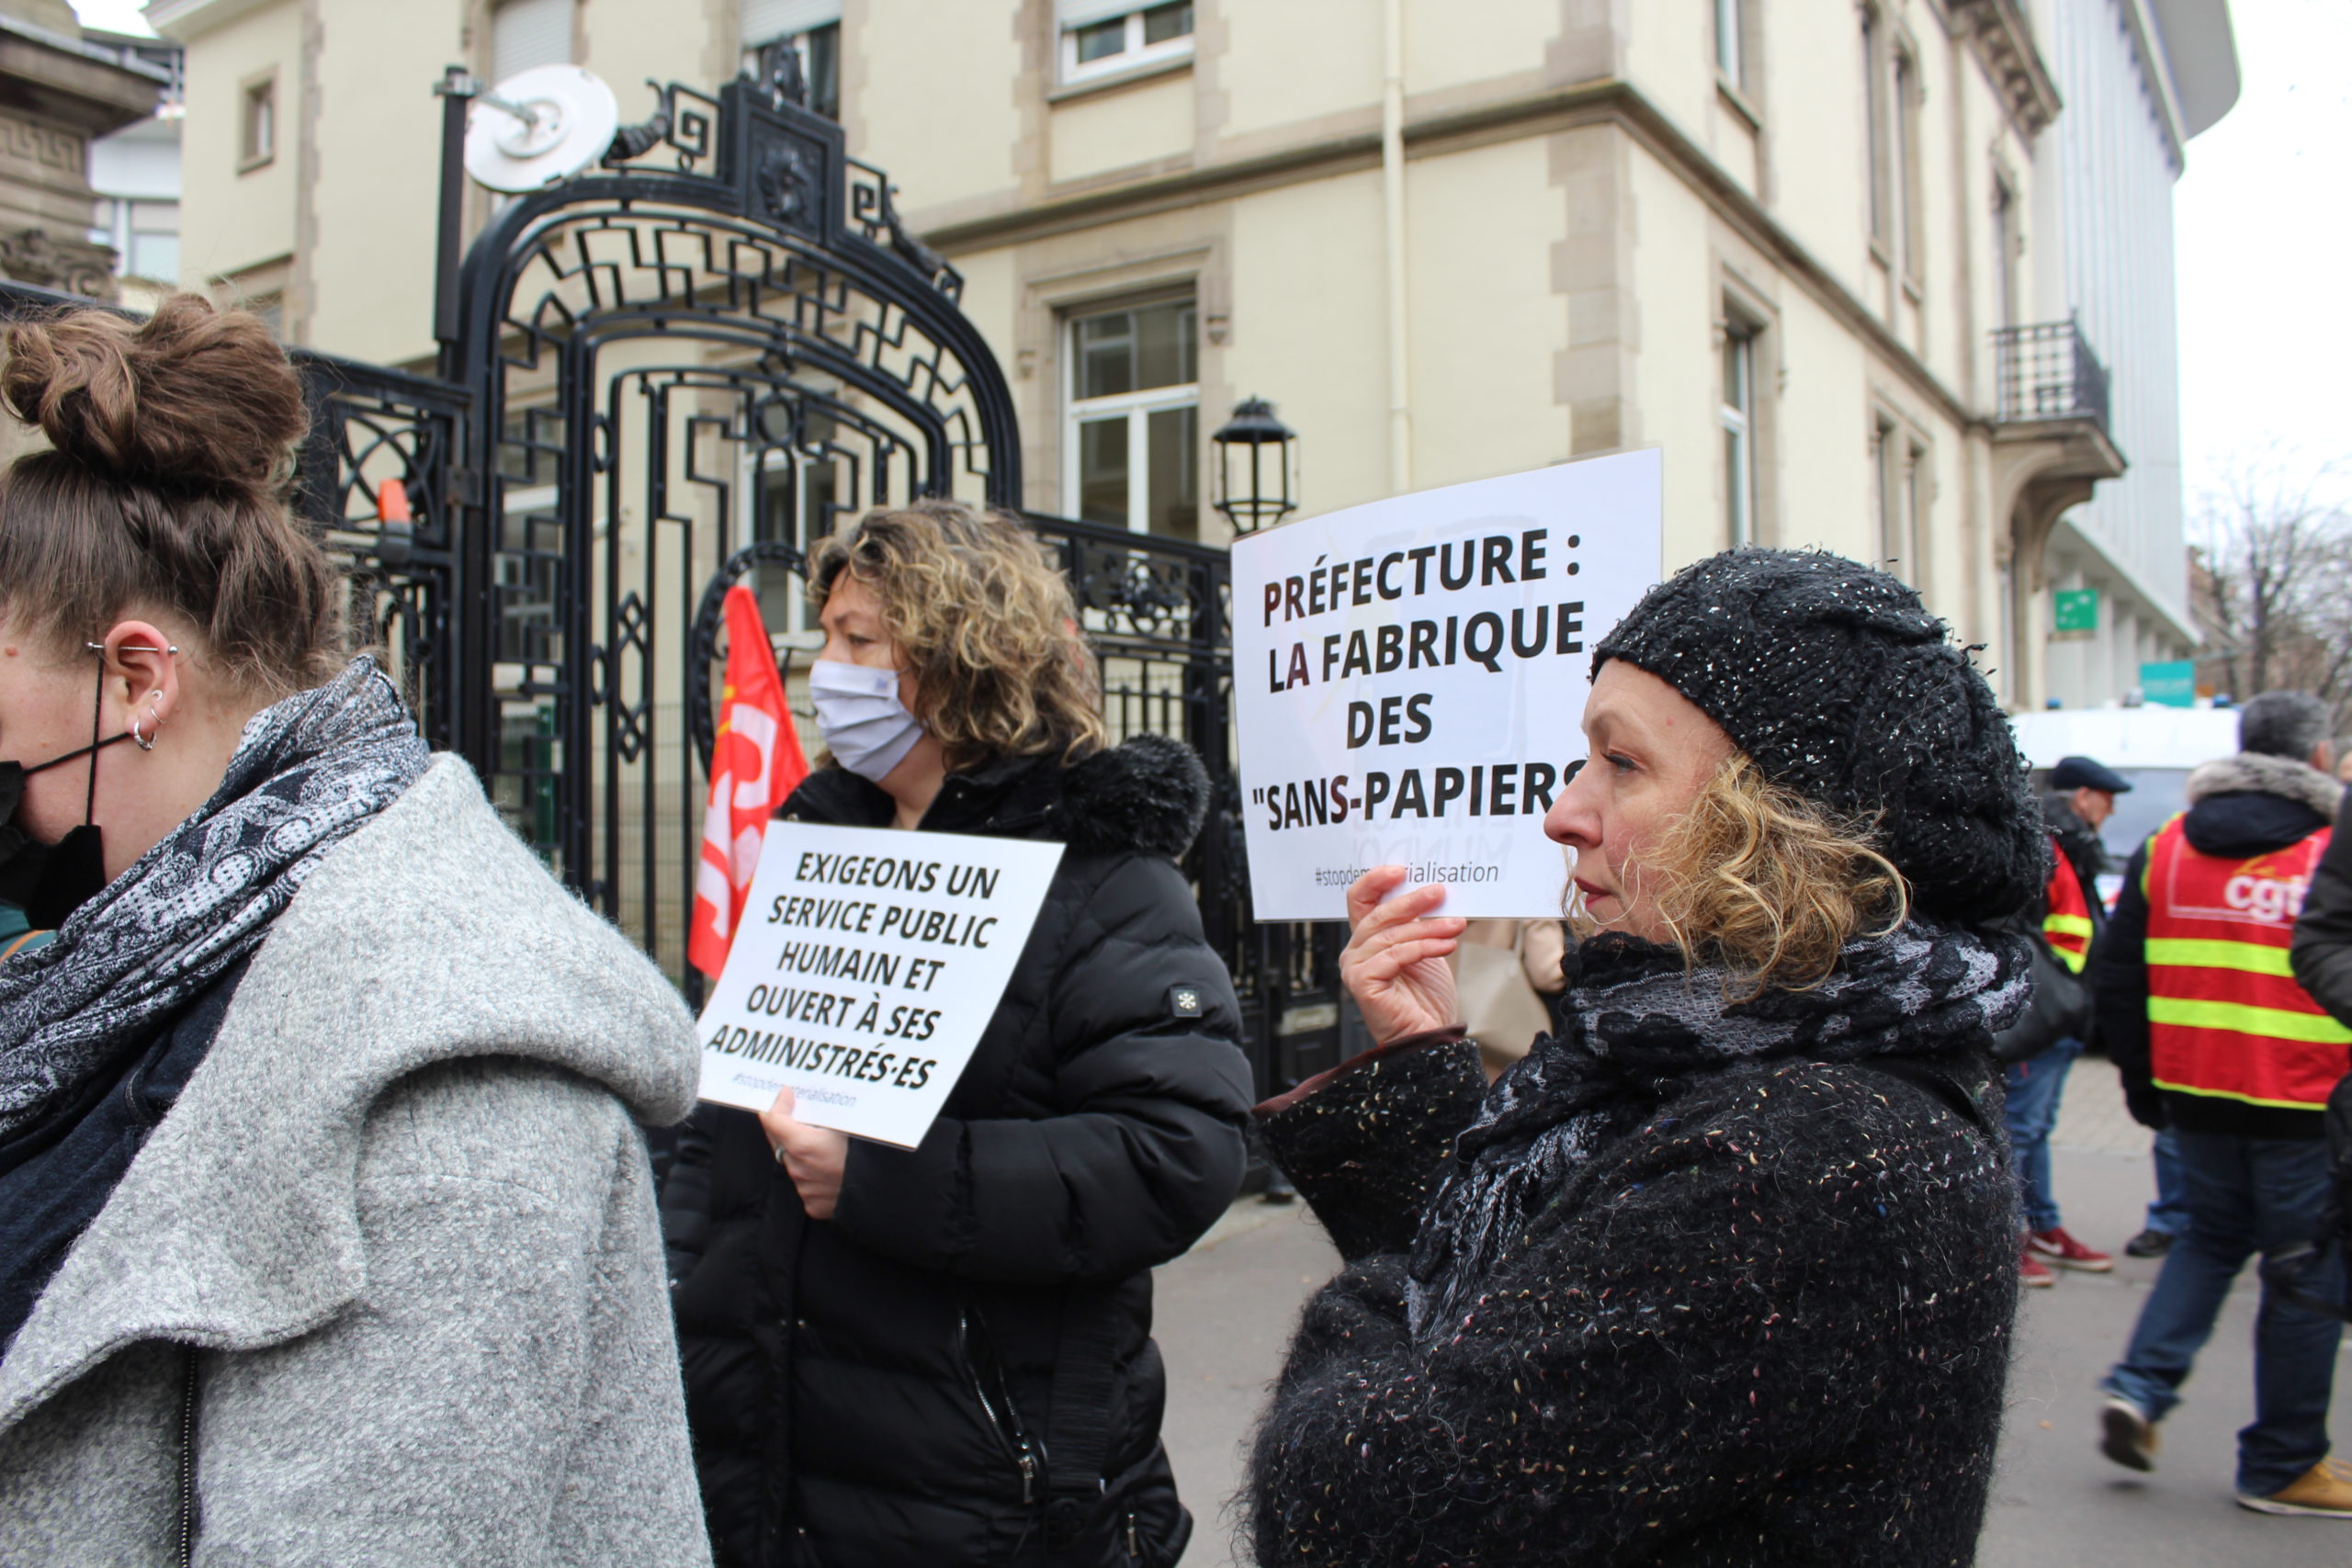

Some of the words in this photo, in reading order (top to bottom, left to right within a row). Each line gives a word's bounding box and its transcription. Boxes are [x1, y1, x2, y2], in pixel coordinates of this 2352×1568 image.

[1264, 528, 1548, 628] PRÉFECTURE
[1567, 535, 1581, 576] :
[1270, 642, 1310, 694] LA
[1322, 601, 1585, 682] FABRIQUE
[1347, 693, 1433, 750] DES
[1252, 759, 1588, 831] "SANS-PAPIER
[795, 852, 942, 893] EXIGEONS
[945, 864, 1001, 900] UN
[2224, 874, 2307, 922] cgt
[767, 895, 878, 933] SERVICE
[878, 906, 999, 949] PUBLIC
[777, 942, 901, 987] HUMAIN
[903, 957, 946, 992] ET
[747, 984, 856, 1028] OUVERT
[854, 992, 880, 1033] À
[883, 1005, 943, 1042] SES
